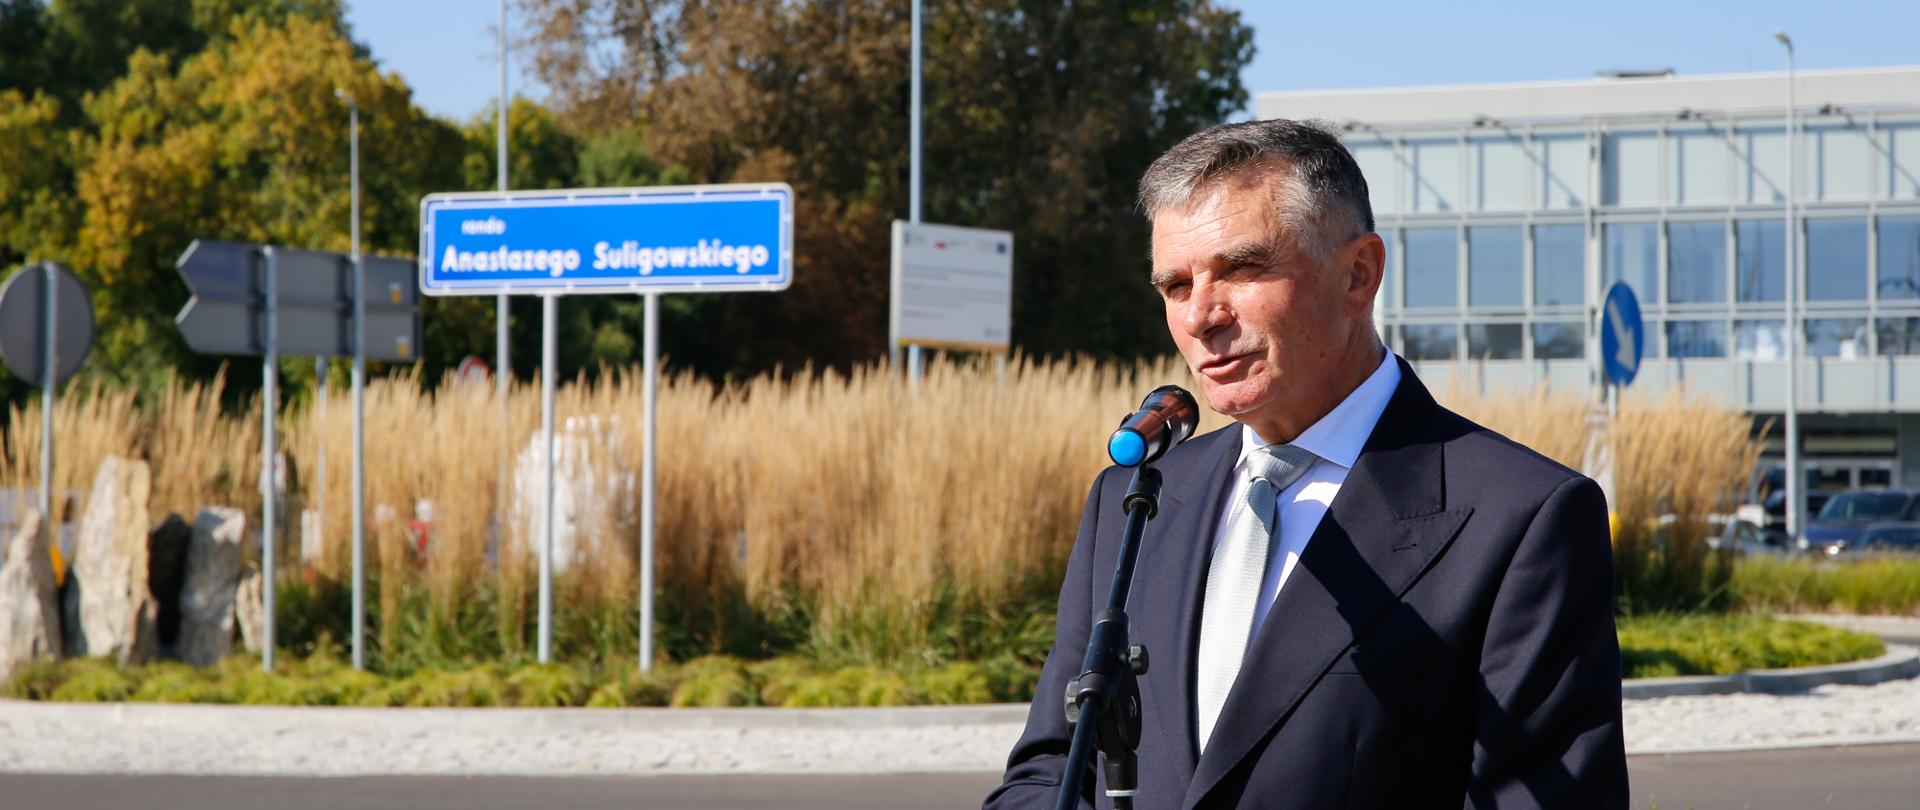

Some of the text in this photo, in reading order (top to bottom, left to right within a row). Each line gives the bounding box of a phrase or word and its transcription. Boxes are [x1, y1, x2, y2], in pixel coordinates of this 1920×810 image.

[461, 216, 506, 235] rondo
[441, 239, 769, 277] Anastazego Suligowskiego
